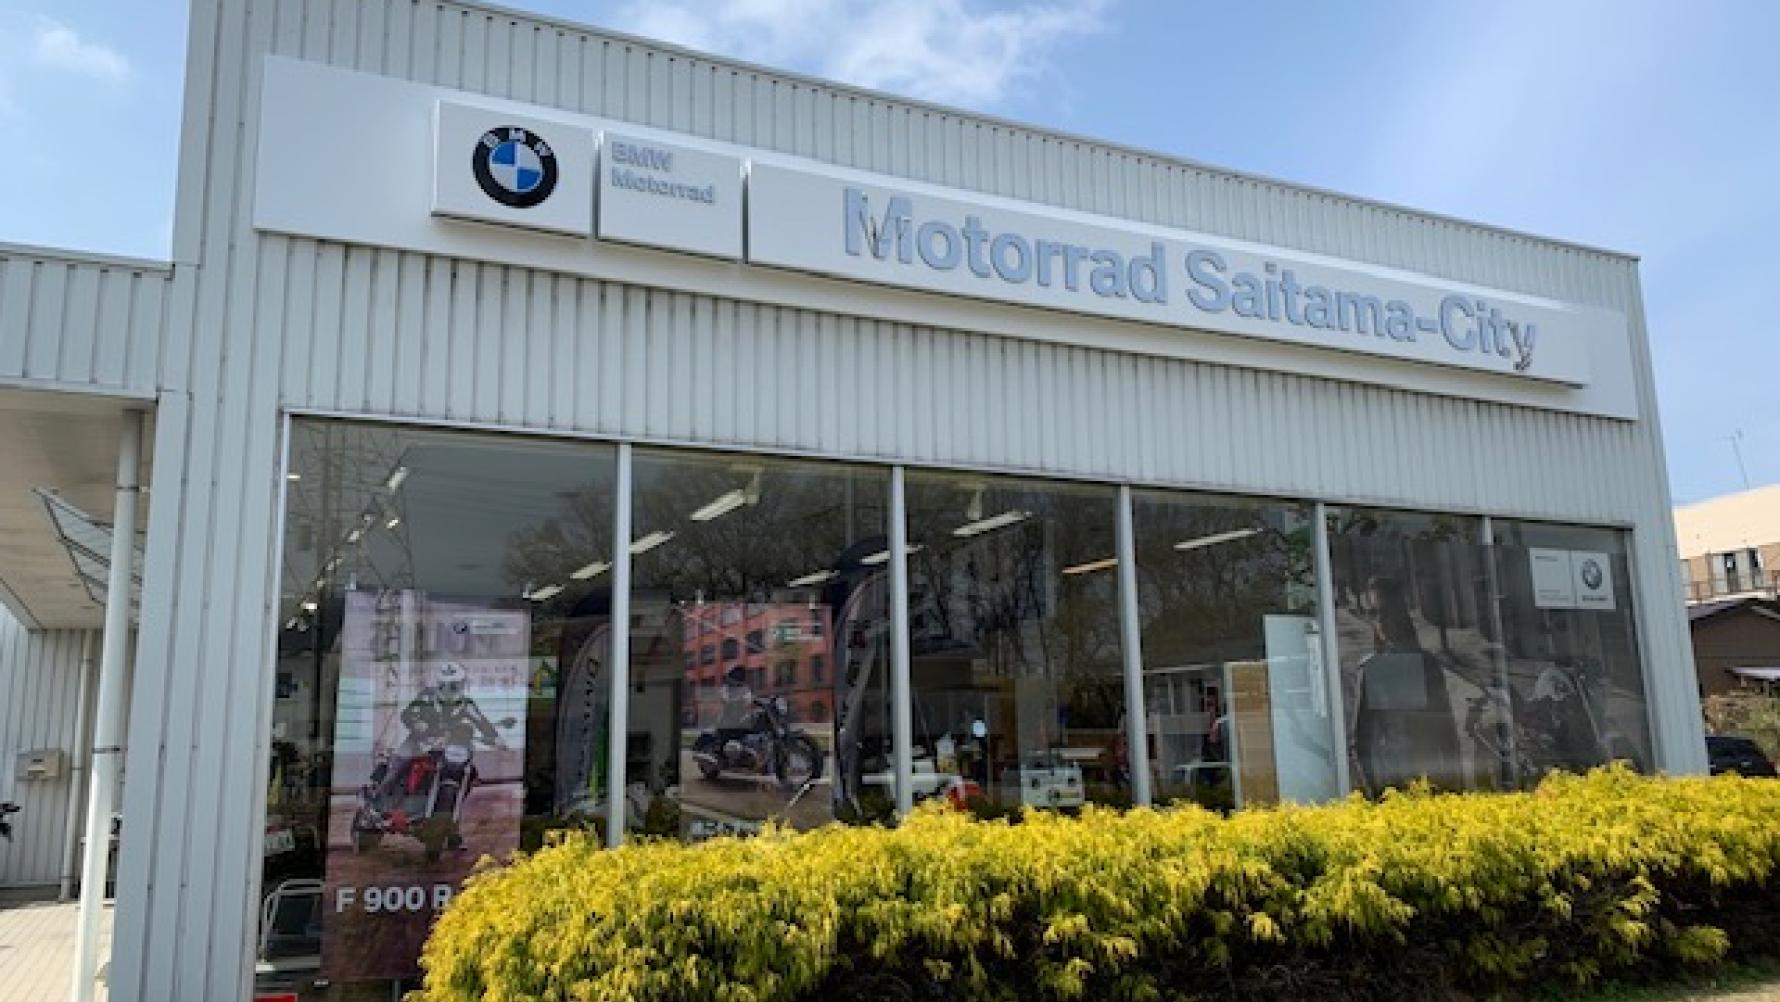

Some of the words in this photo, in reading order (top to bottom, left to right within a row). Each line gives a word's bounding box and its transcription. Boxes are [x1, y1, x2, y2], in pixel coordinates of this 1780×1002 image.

[611, 141, 672, 171] BMW
[611, 166, 713, 203] Motorrad
[843, 186, 1169, 306] Motorrad
[1185, 249, 1537, 371] Saitama-City
[336, 886, 357, 912] F
[364, 886, 426, 912] 900
